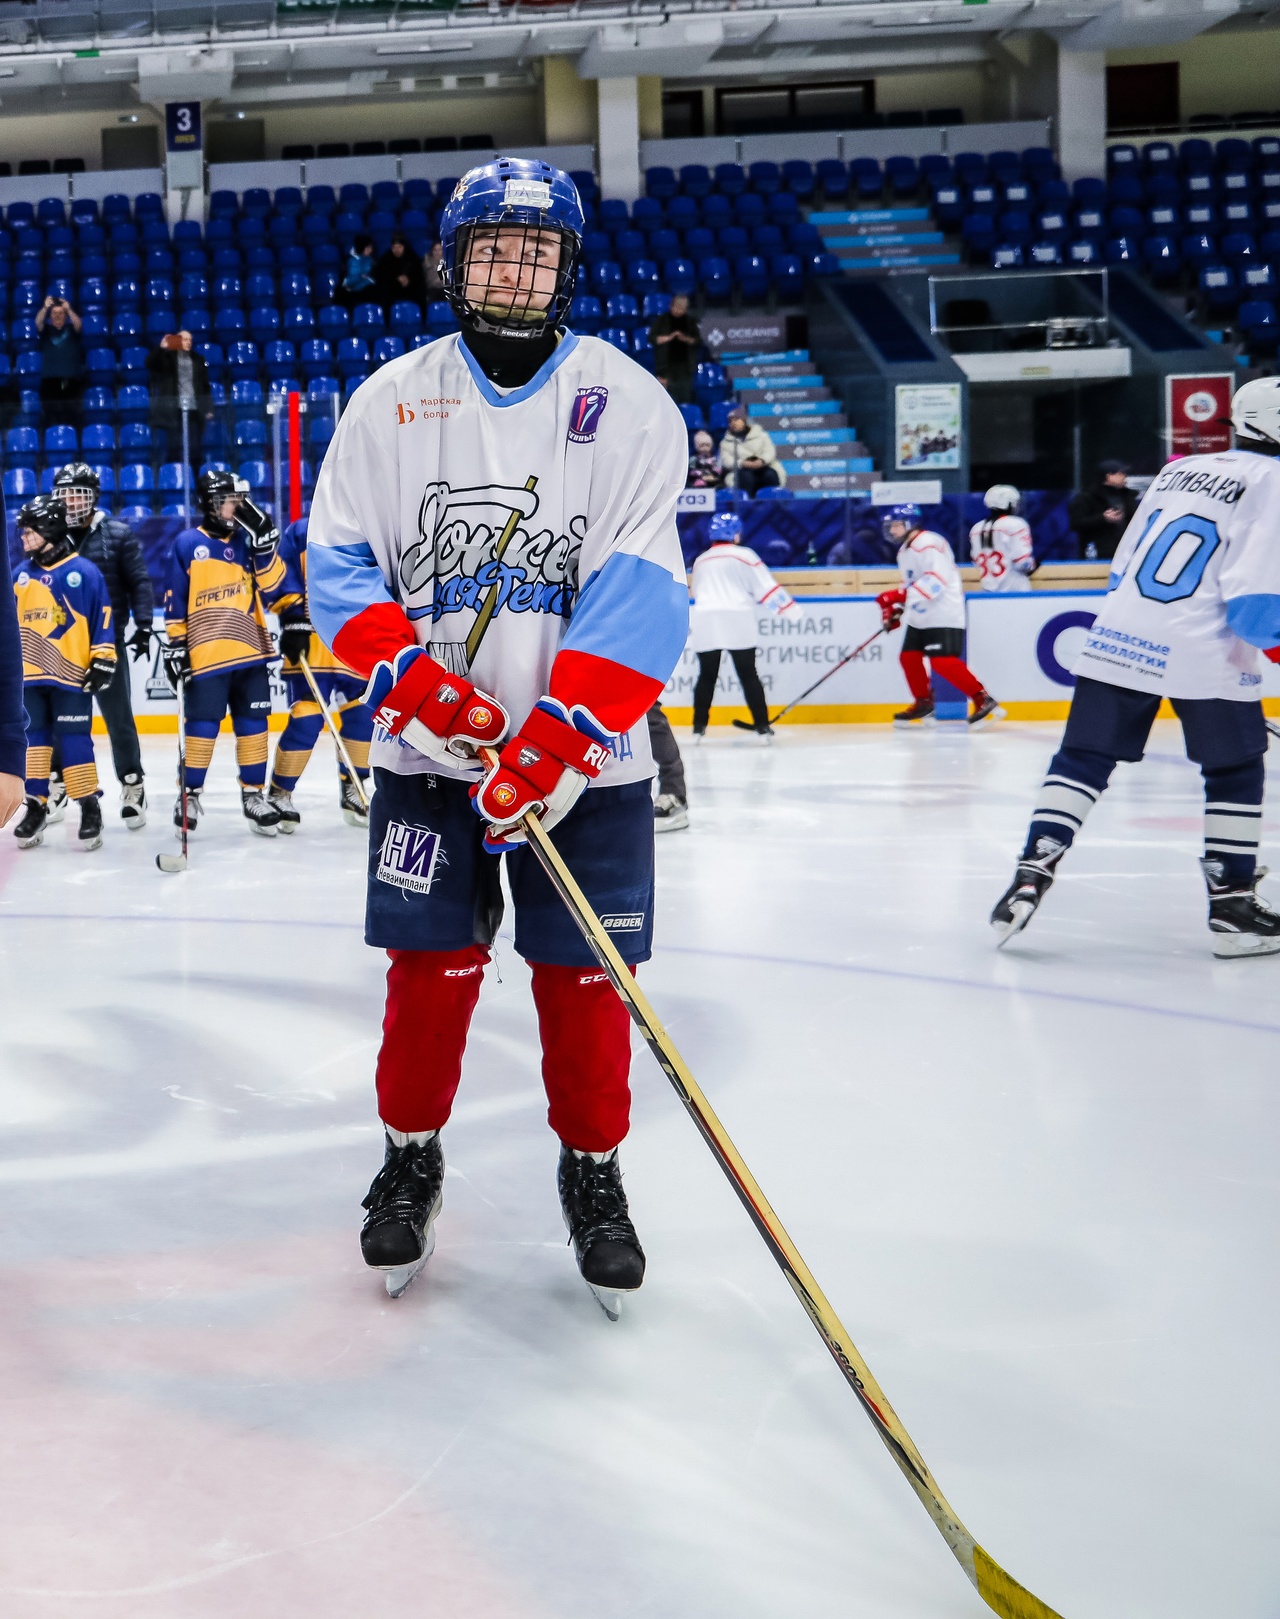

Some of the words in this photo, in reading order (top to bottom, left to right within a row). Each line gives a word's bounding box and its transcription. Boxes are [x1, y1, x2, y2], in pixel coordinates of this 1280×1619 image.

[177, 108, 192, 131] 3
[501, 329, 530, 338] Reebok
[195, 588, 241, 607] СТРЕЛКА
[384, 823, 441, 879] НИ
[378, 866, 430, 893] Неваимплант
[830, 1340, 865, 1390] 3600
